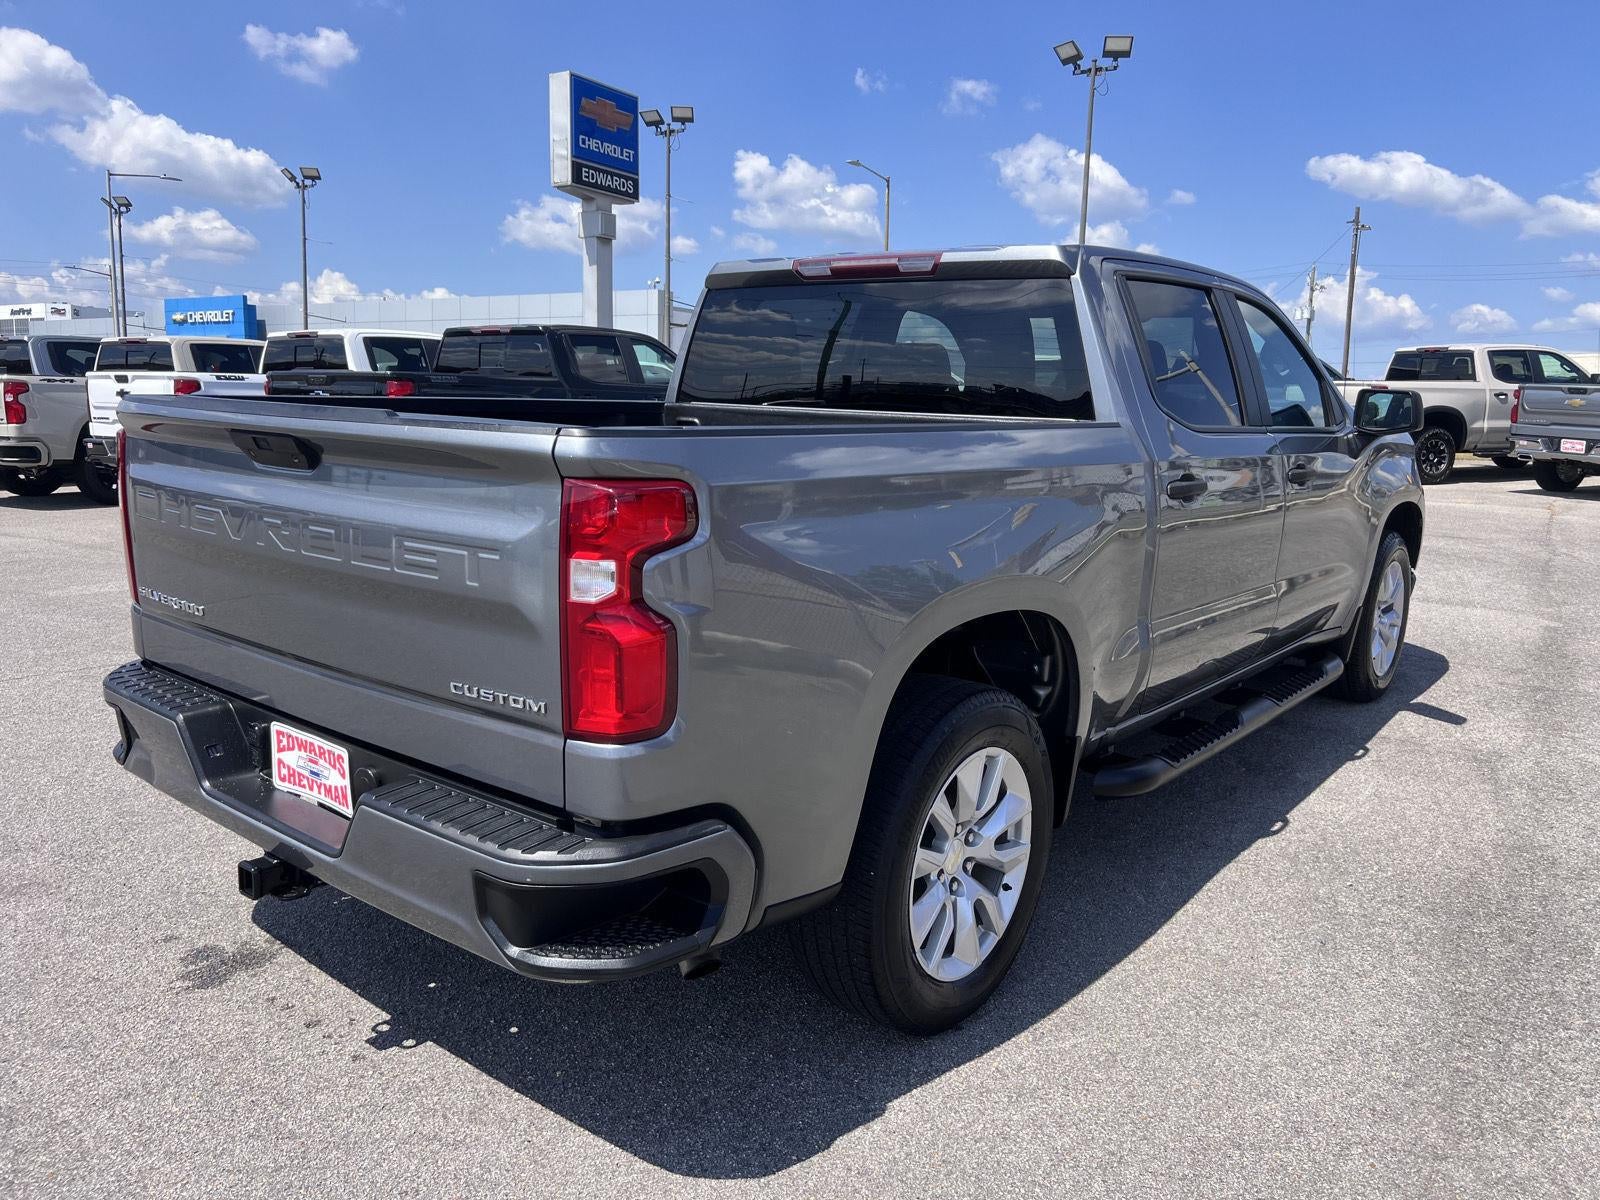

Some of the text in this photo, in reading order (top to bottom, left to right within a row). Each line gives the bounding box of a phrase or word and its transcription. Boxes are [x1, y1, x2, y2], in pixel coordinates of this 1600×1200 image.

[579, 134, 634, 162] CHEVROLET
[582, 167, 634, 193] EDWARDS
[187, 310, 233, 323] CHEVROLET
[134, 484, 500, 587] CHEVROLET
[139, 586, 205, 617] SILVERADO
[449, 681, 547, 714] CUSTOM
[275, 729, 346, 780] EDWARDS
[276, 757, 350, 809] CHEVYMAN
